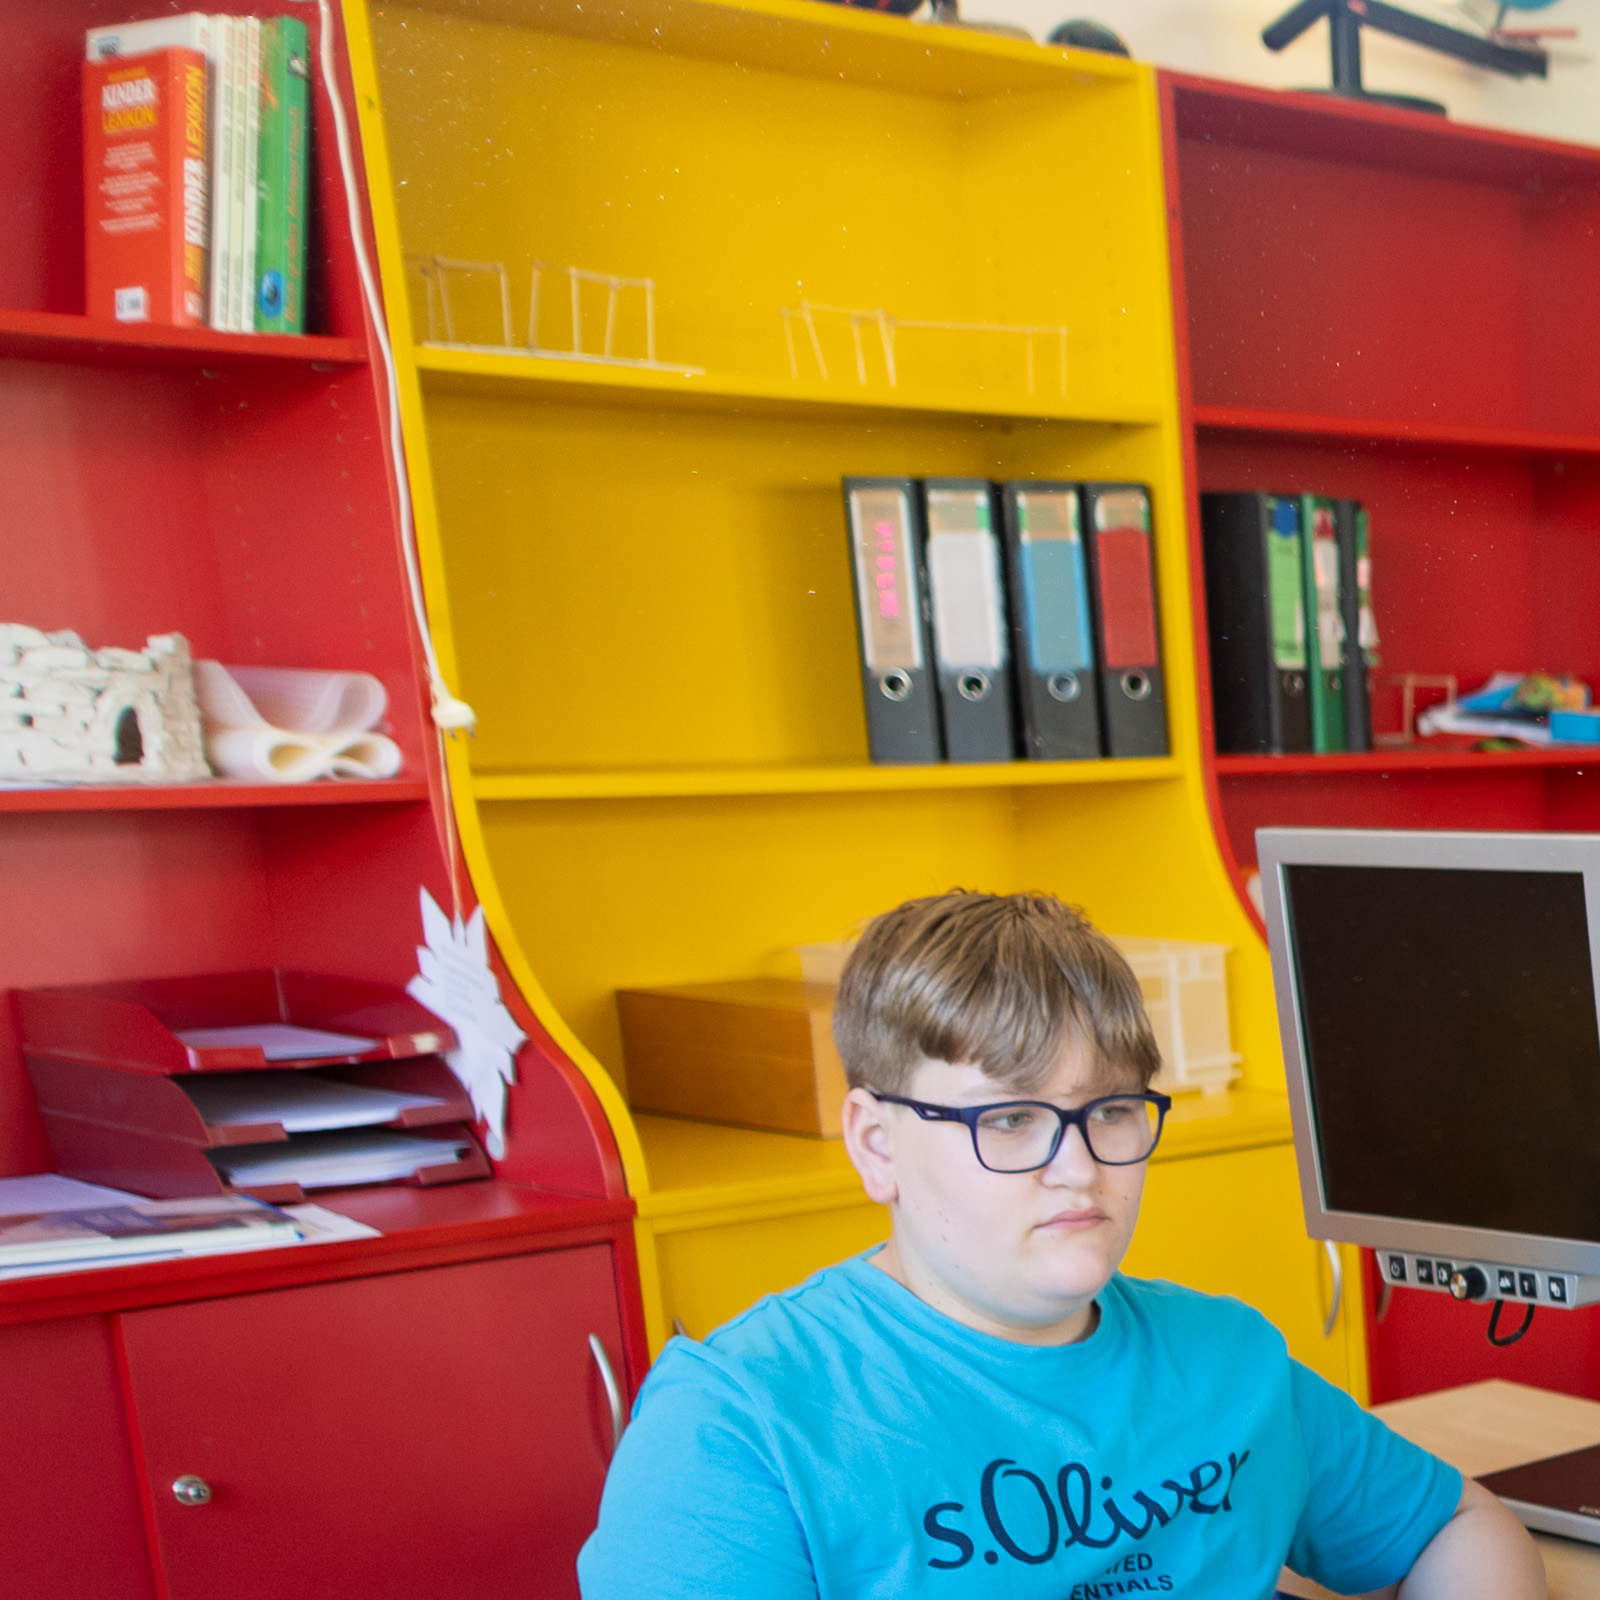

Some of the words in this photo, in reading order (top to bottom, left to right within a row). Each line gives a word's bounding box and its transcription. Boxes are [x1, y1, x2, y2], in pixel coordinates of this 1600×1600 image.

[102, 78, 157, 110] KINDER
[103, 106, 157, 134] LEXIKON
[186, 64, 206, 156] LEXIKON
[184, 157, 207, 248] KINDER
[923, 1449, 1250, 1570] s.Oliver
